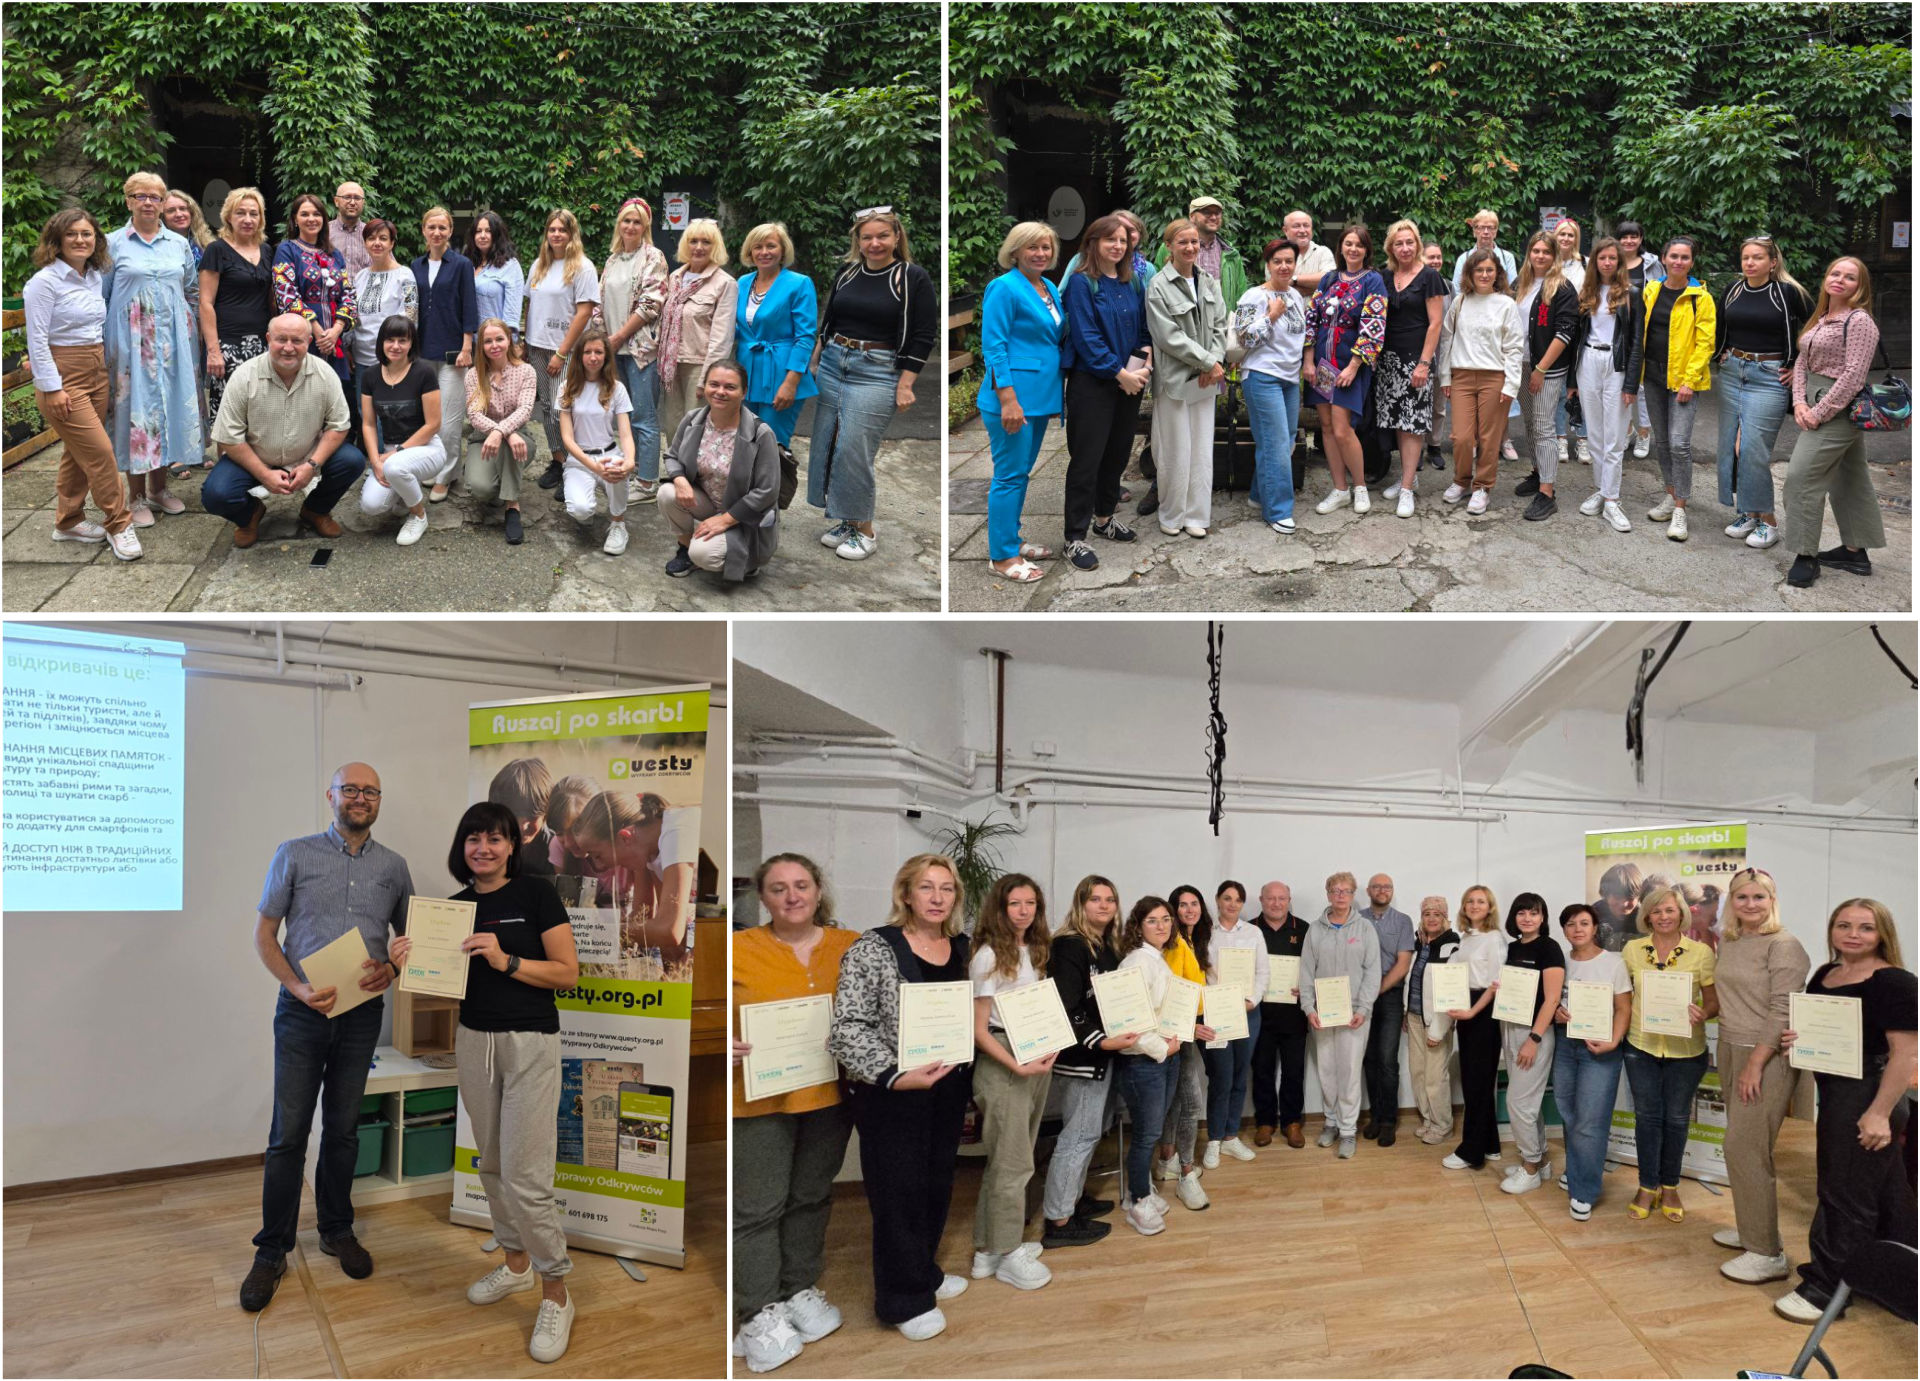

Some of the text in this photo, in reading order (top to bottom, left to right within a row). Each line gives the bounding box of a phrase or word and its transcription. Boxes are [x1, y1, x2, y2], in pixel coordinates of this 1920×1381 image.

[8, 653, 150, 682] відкривачів це:
[59, 694, 102, 705] можуть
[105, 697, 147, 708] спільно
[27, 701, 41, 709] не
[45, 702, 80, 712] тільки
[83, 705, 129, 717] туристи,
[132, 710, 151, 718] але
[93, 717, 137, 727] завдяки
[140, 722, 168, 731] чому
[493, 700, 684, 735] Ruszaj po skarb!
[5, 719, 41, 729] регіон
[55, 723, 124, 736] зміцнюється
[128, 728, 170, 739] місцева
[49, 745, 108, 759] МІСЦЕВИХ
[111, 749, 166, 761] ПАМЯТОК
[5, 755, 155, 771] види унікальної спадщини
[35, 767, 46, 775] та
[49, 768, 101, 778] природу;
[37, 779, 79, 790] забавні
[83, 783, 112, 792] рими
[128, 785, 173, 795] загадки,
[55, 792, 96, 800] шукати
[98, 793, 129, 803] скарб
[16, 813, 96, 823] користуватися
[113, 816, 175, 826] допомогою
[16, 823, 62, 833] додатку
[88, 824, 149, 835] смартфонів
[1601, 830, 1731, 850] Ruszaj po skarb!
[12, 843, 58, 854] ДОСТУП
[61, 845, 83, 854] НІЖ
[86, 845, 93, 854] В
[96, 845, 172, 857] ТРАДИЦІЙНИХ
[55, 855, 110, 864] достатньо
[31, 863, 115, 874] інфраструктури
[118, 865, 137, 873] або
[577, 1031, 598, 1039] strony
[599, 1034, 664, 1046] www.questy.org.pl
[555, 1170, 664, 1196] yprawy Odkrywców
[568, 1209, 580, 1217] 601
[582, 1211, 595, 1220] 698
[596, 1214, 608, 1222] 175
